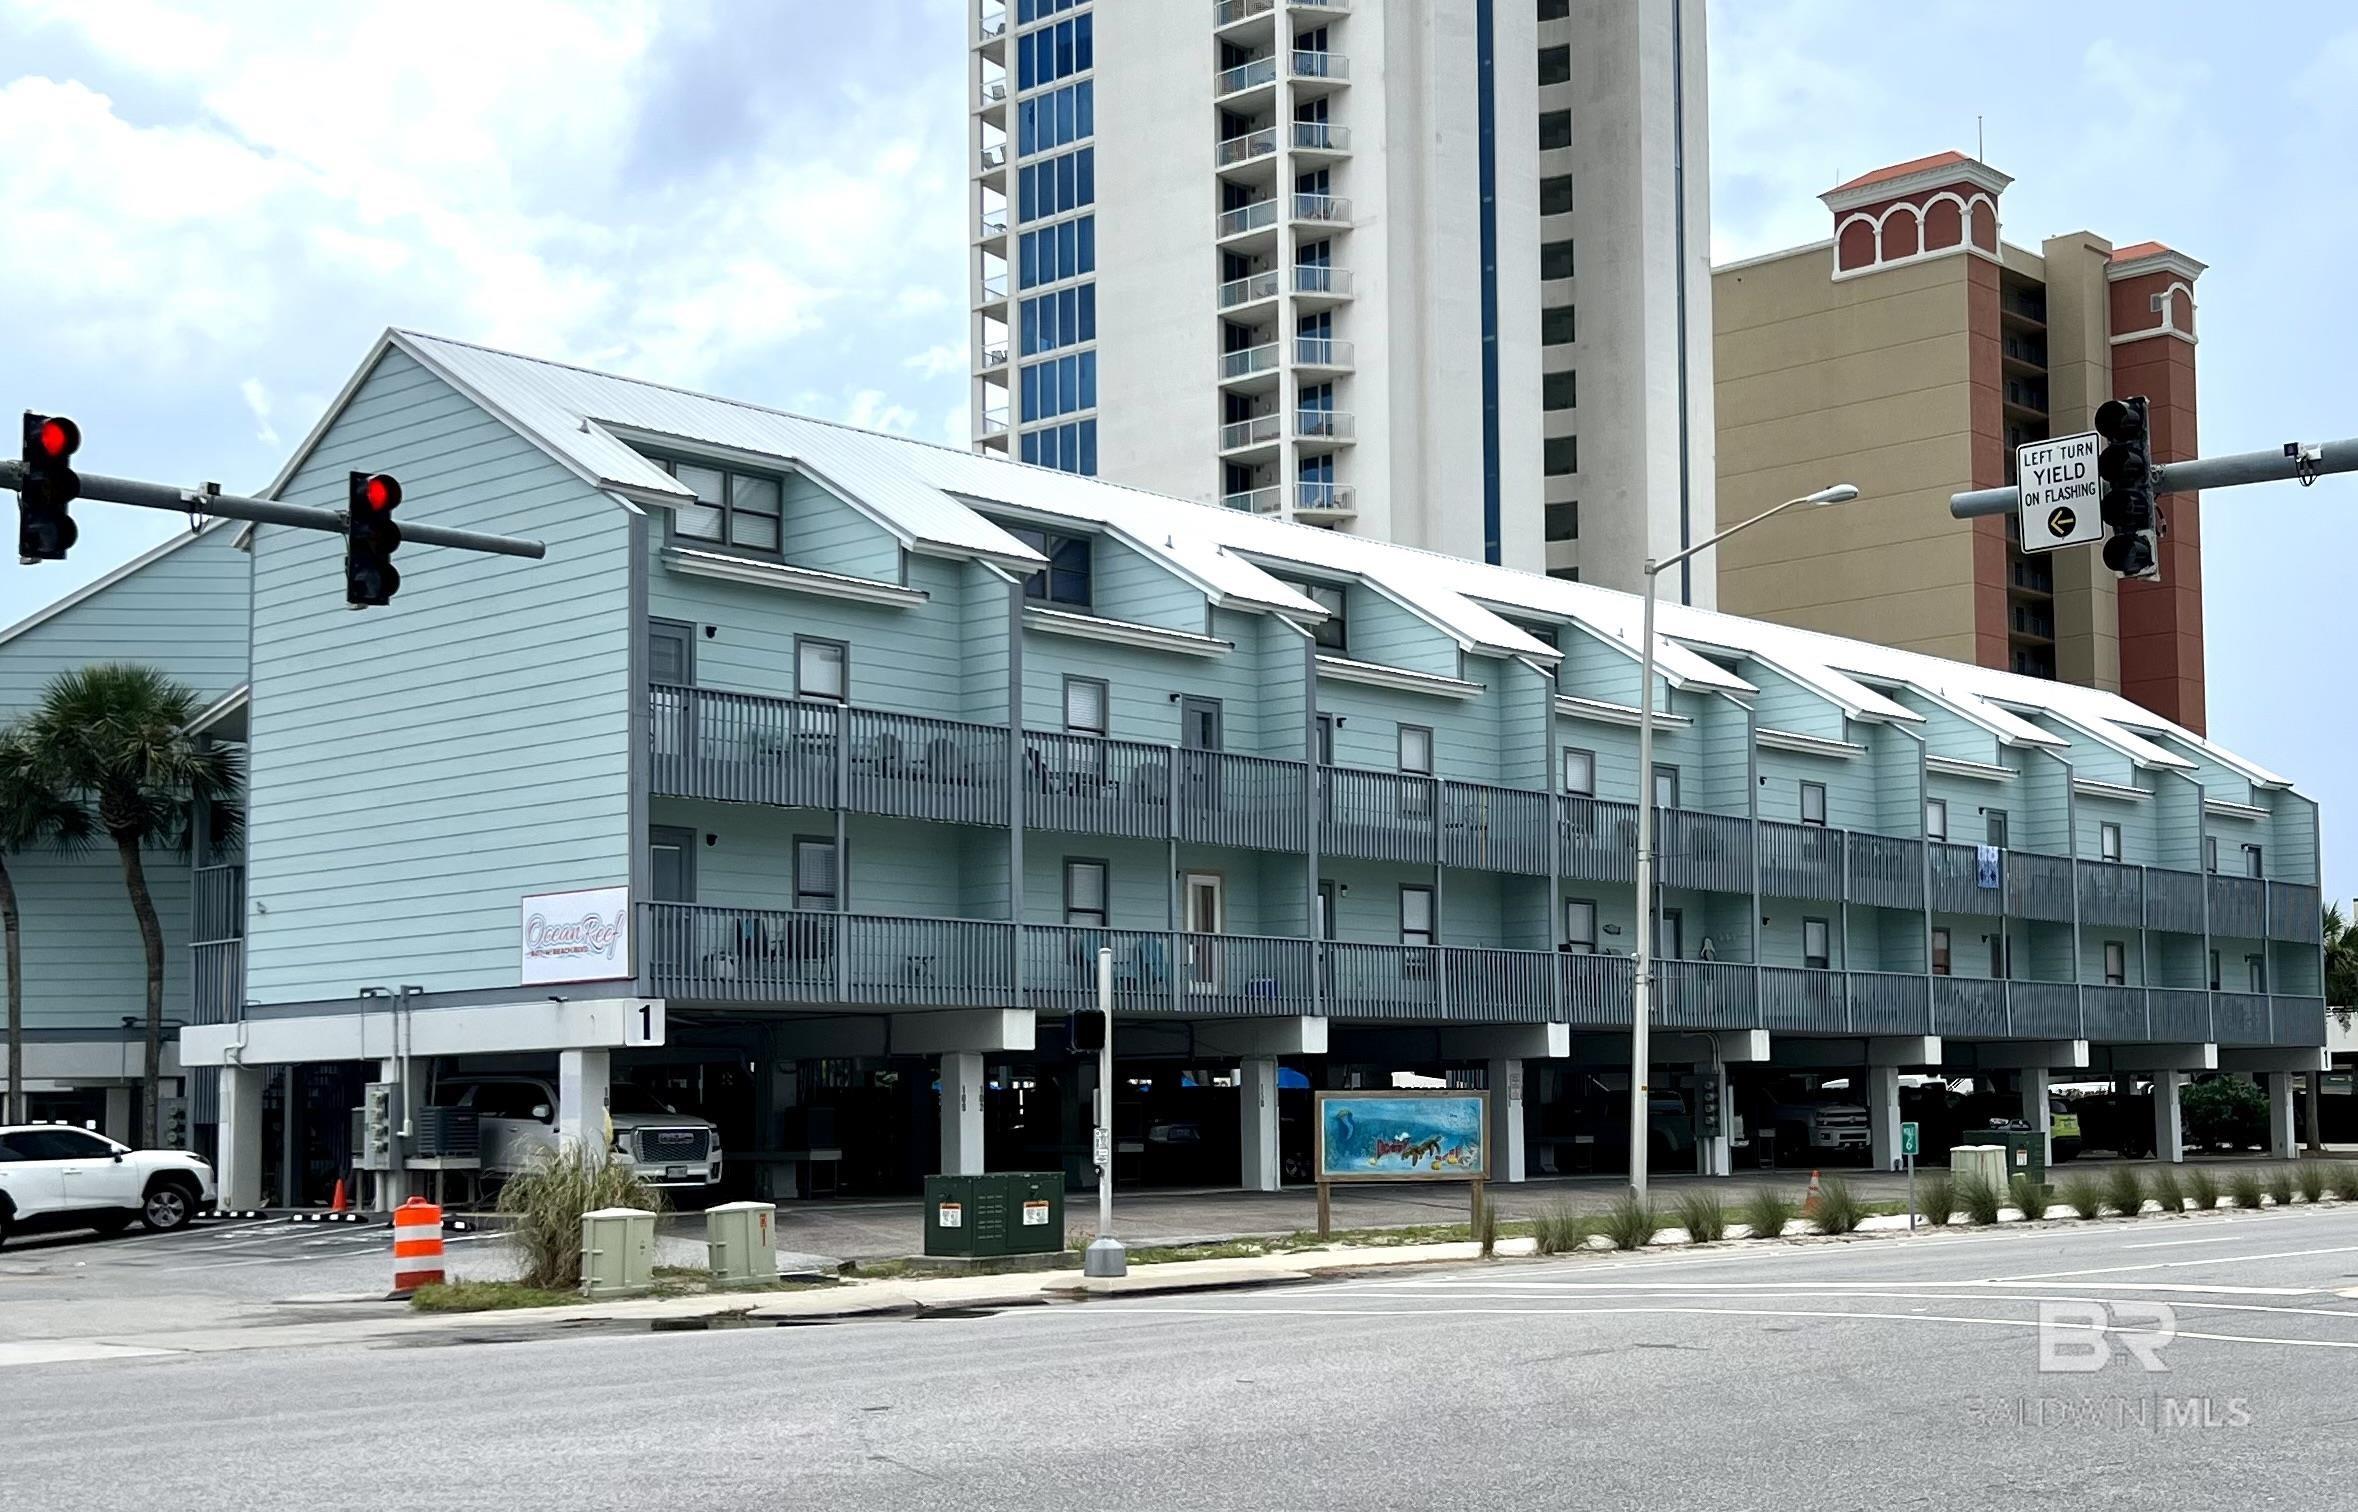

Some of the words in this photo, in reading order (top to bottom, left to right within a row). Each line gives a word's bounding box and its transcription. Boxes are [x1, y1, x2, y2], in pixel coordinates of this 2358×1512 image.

[2024, 449, 2053, 467] LEFT
[2061, 441, 2093, 460] TURN
[2034, 462, 2086, 486] YIELD
[2025, 493, 2040, 507] ON
[2045, 482, 2096, 503] FLASHING
[526, 914, 582, 949] Ocean
[582, 910, 625, 959] Reef
[639, 1004, 651, 1040] 1
[2323, 1050, 2329, 1068] 1
[1905, 1136, 1913, 1150] 6
